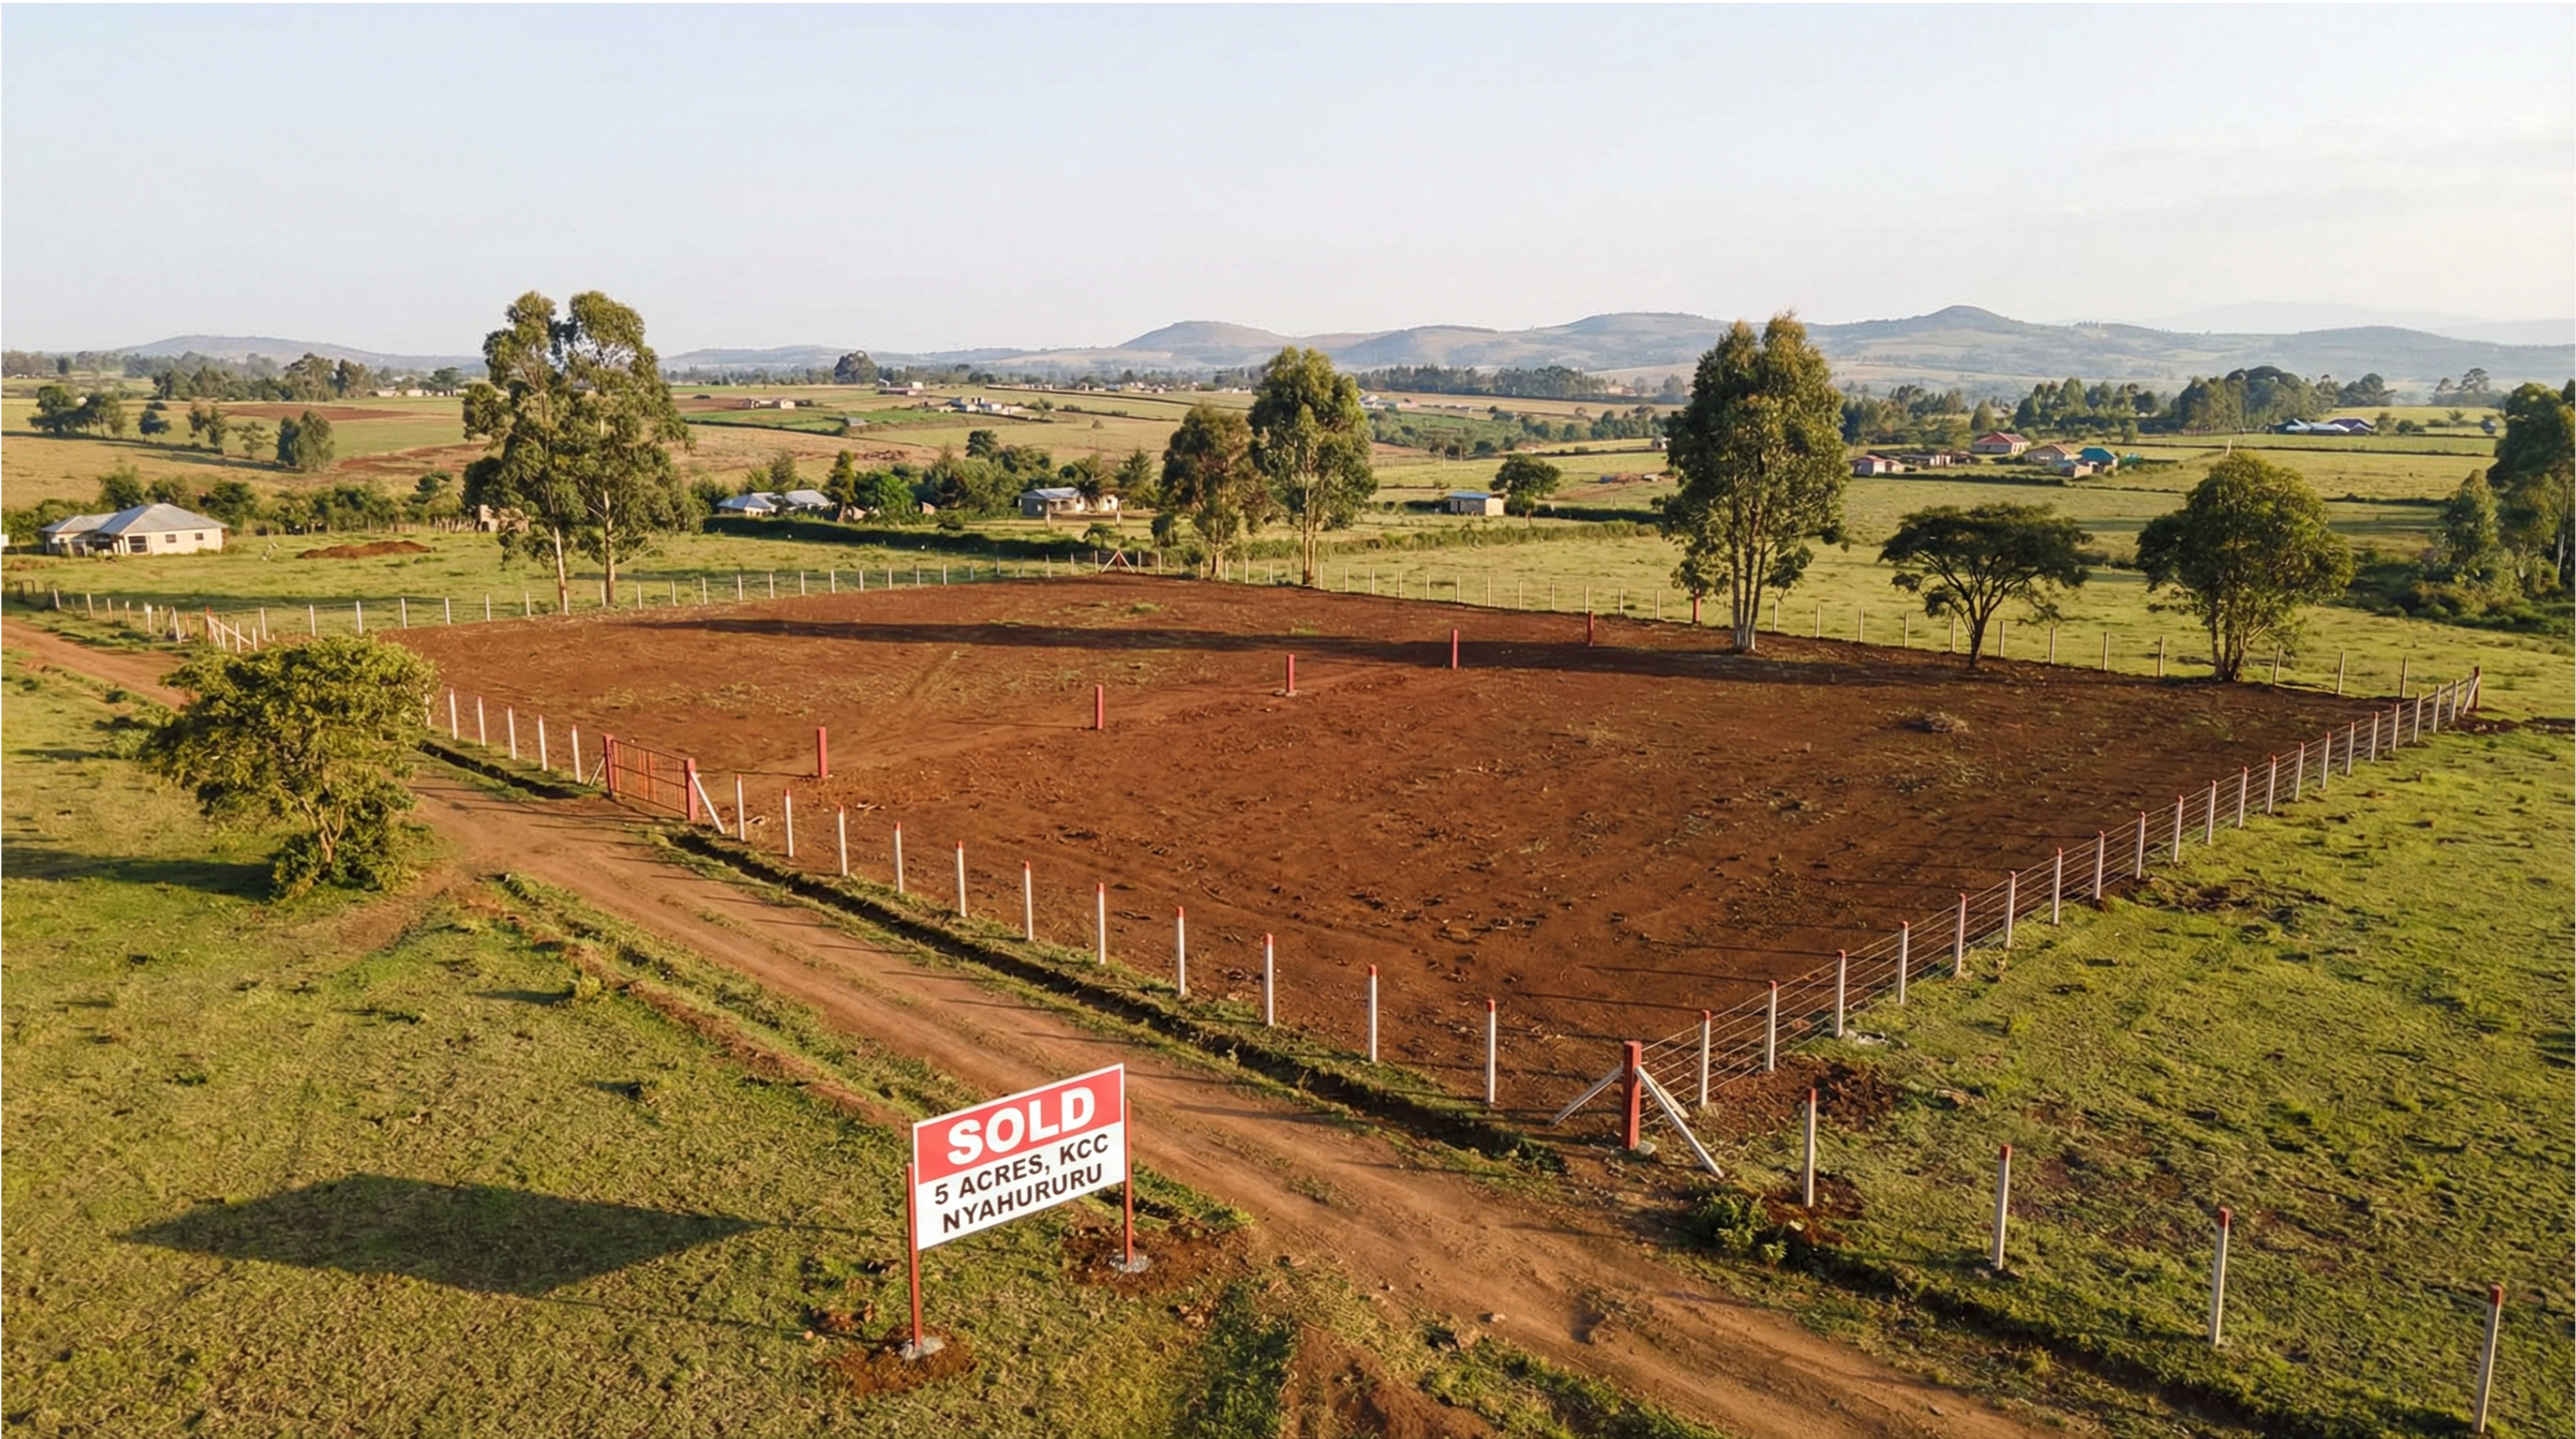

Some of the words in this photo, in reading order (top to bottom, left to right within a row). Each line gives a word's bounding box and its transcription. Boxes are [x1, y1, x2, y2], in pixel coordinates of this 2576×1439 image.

[947, 1086, 1095, 1166] SOLD
[934, 1183, 949, 1205] 5
[958, 1154, 1051, 1199] ACRES,
[1059, 1133, 1109, 1166] KCC
[942, 1163, 1103, 1234] NYAHURURU
